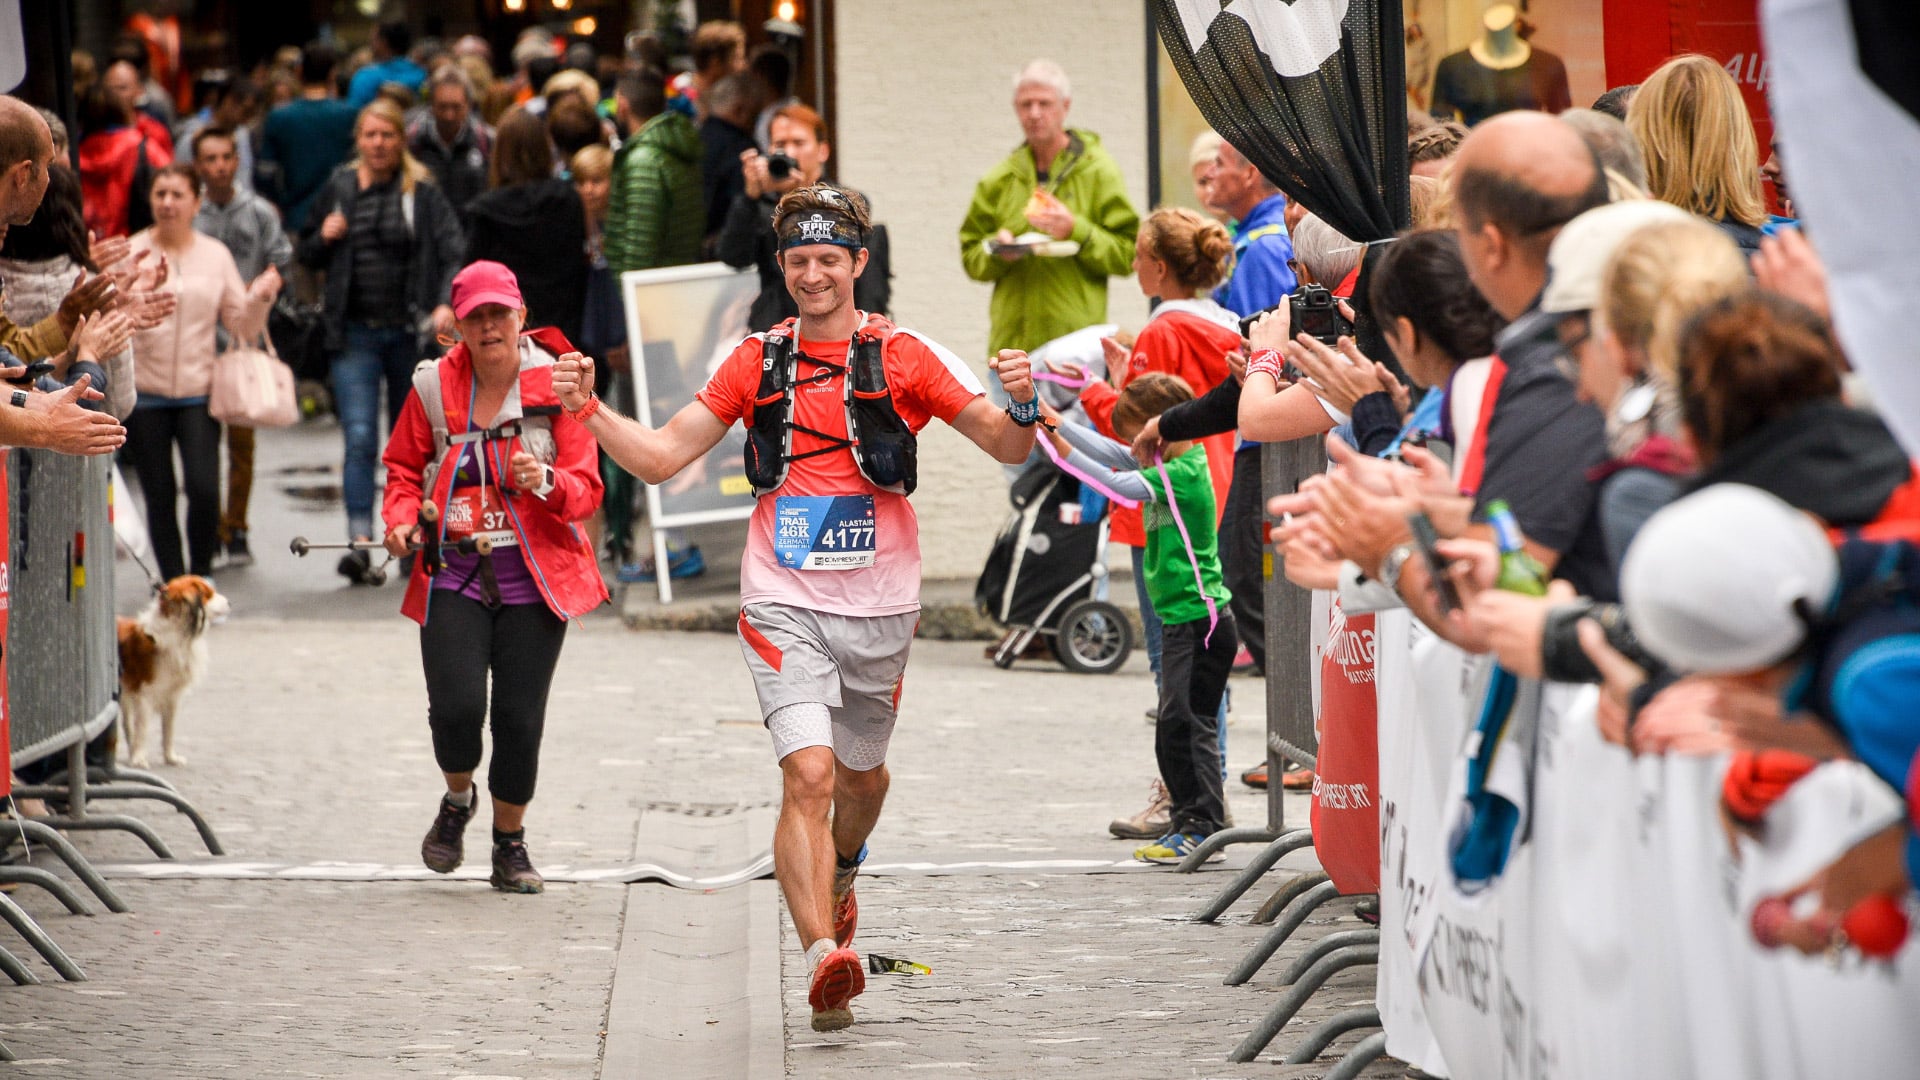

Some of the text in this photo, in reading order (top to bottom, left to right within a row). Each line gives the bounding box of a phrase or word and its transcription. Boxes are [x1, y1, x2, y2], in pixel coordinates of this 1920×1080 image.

[802, 222, 831, 231] EPIC
[483, 511, 511, 530] 37
[779, 517, 809, 526] TRAIL
[779, 526, 810, 538] 46K
[822, 528, 874, 548] 4177
